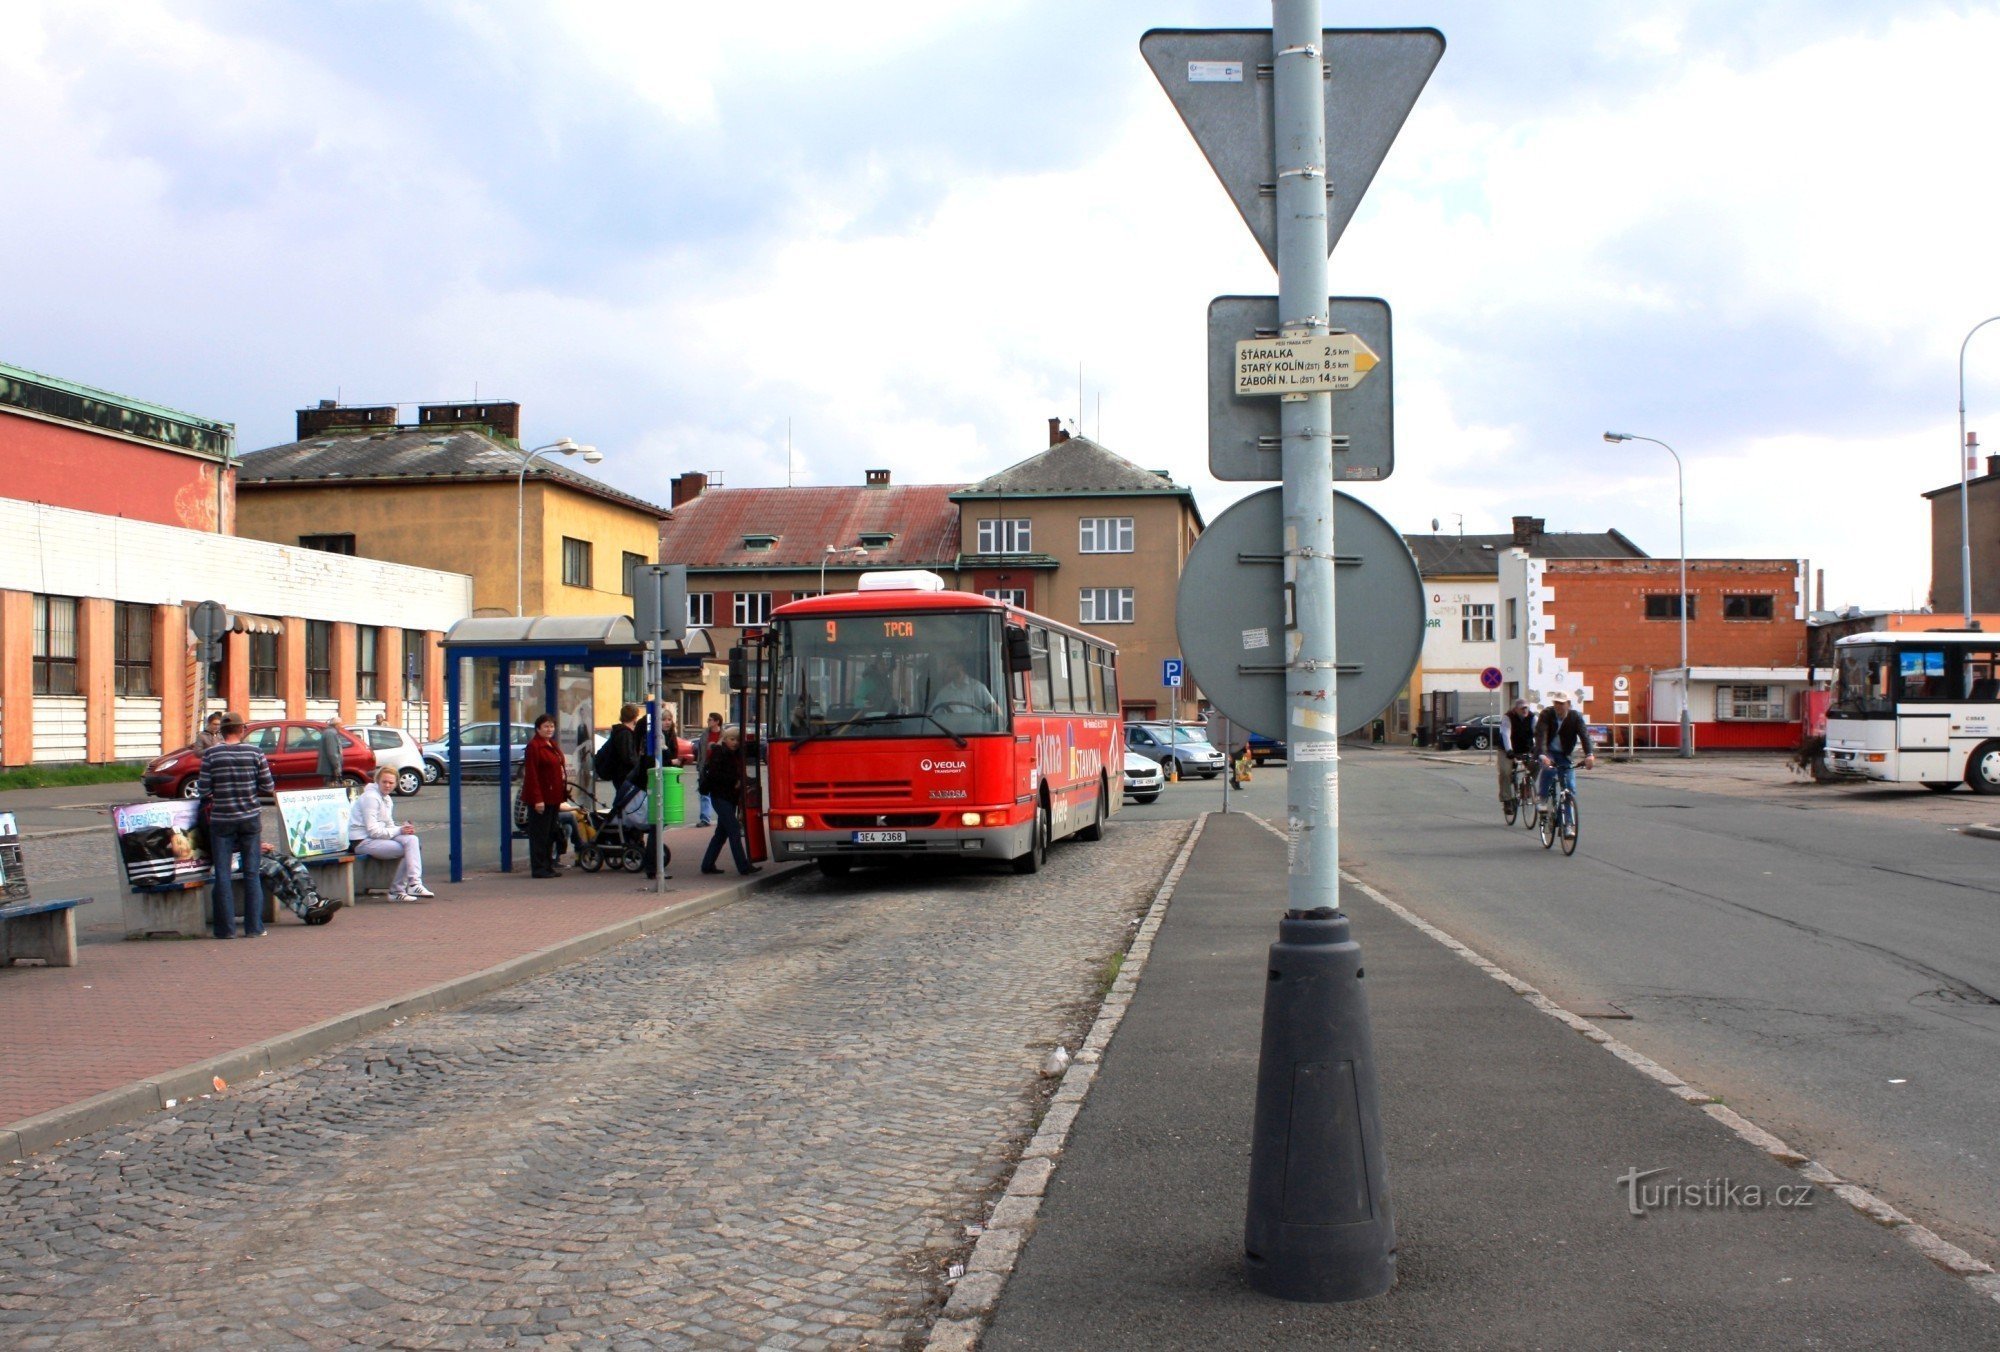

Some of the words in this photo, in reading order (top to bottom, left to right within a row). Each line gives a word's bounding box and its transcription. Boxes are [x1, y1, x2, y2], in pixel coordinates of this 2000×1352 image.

[1241, 348, 1293, 360] ŠŤÁRALKA
[1324, 346, 1337, 356] 2,5
[1241, 361, 1272, 373] STARÝ
[1275, 359, 1304, 371] KOLÍN
[1324, 360, 1336, 370] 8,5
[1240, 374, 1276, 387] ZÁBOŘÍ
[1279, 375, 1288, 385] N.
[1291, 375, 1299, 384] L.
[1319, 373, 1336, 383] 14,5
[826, 620, 837, 642] 9
[883, 621, 913, 638] TPCA
[1166, 662, 1179, 679] P
[1036, 718, 1062, 776] okna
[933, 761, 967, 769] VEOLIA
[929, 789, 968, 799] KAROSA
[859, 832, 876, 842] 3E4
[881, 832, 903, 842] 2368
